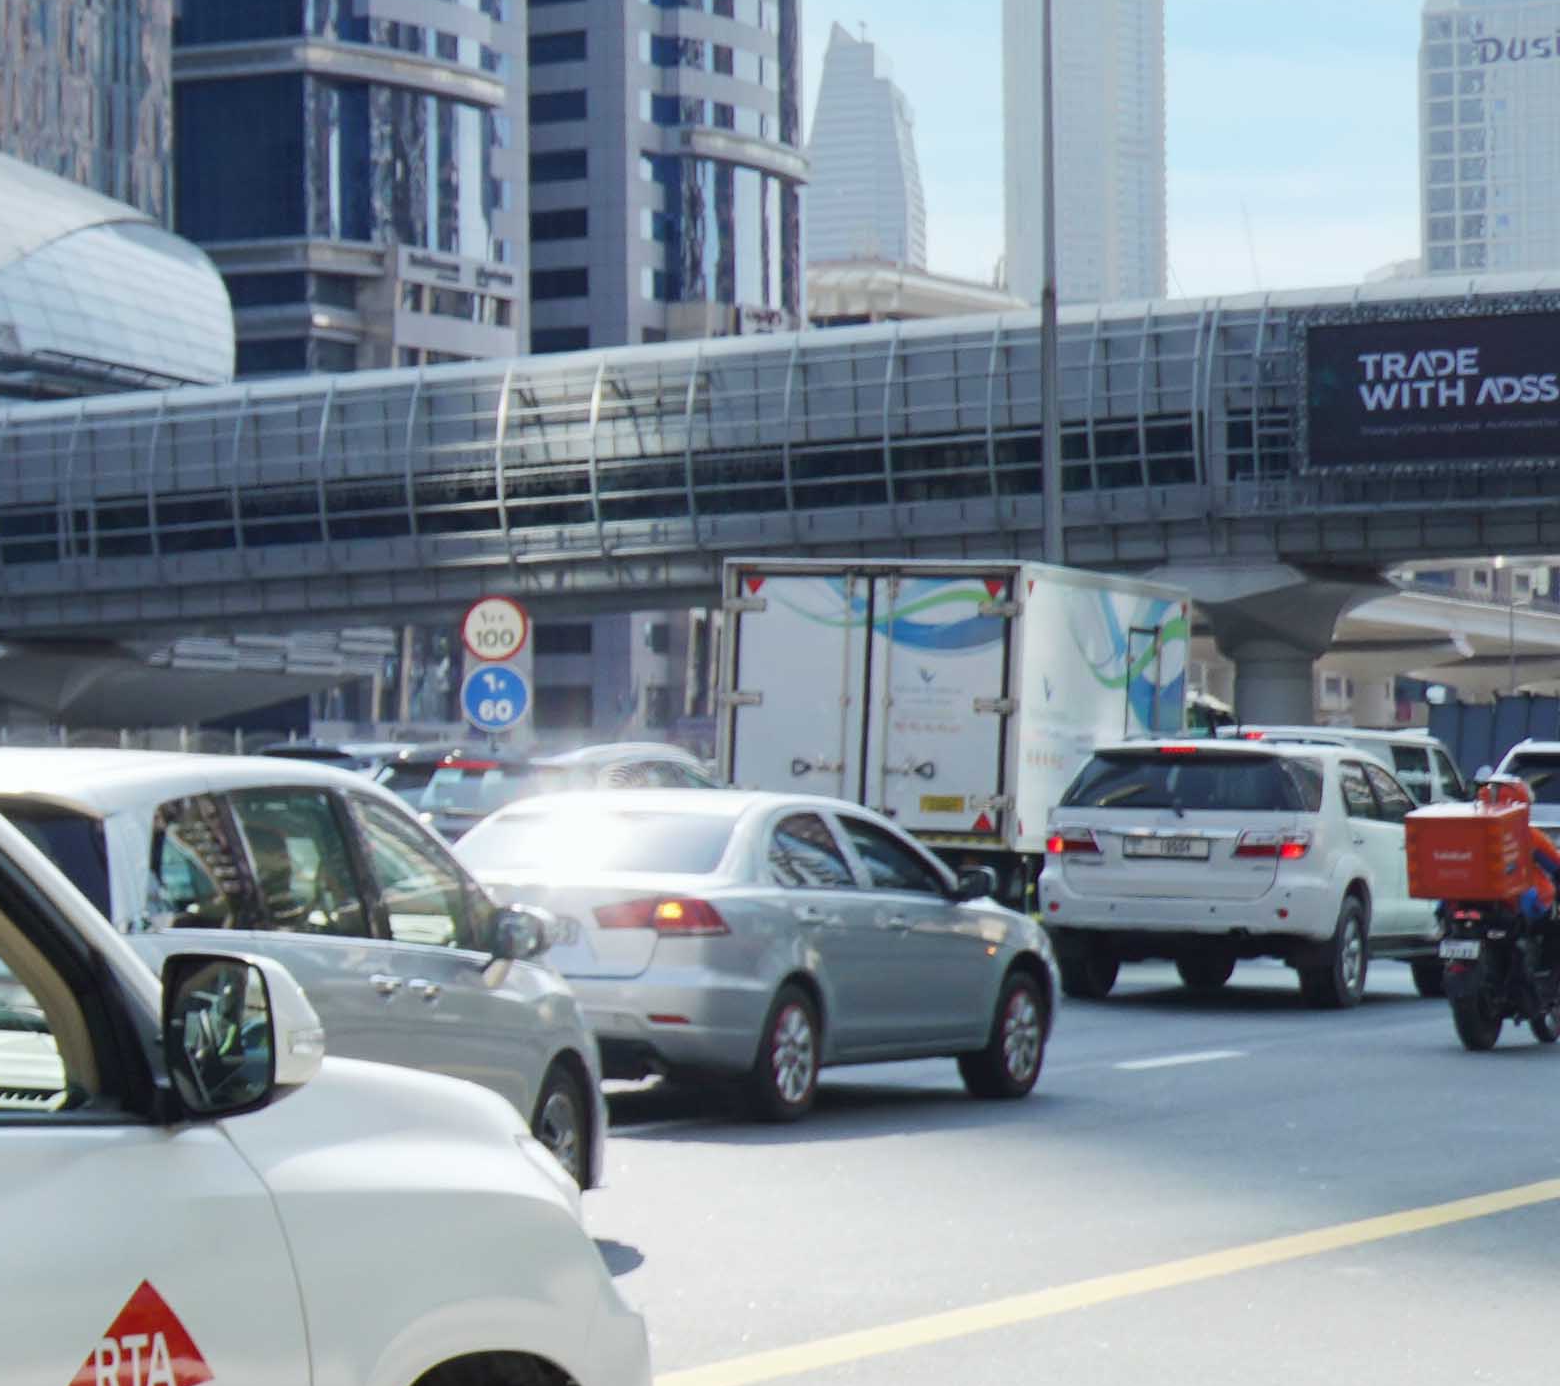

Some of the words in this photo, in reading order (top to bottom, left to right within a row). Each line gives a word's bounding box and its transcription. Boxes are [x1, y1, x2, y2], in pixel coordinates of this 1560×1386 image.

[1358, 347, 1481, 381] TRADE
[1358, 379, 1466, 411] WITH
[1475, 373, 1560, 406] ADSS
[476, 628, 515, 647] 100
[478, 699, 513, 722] 60
